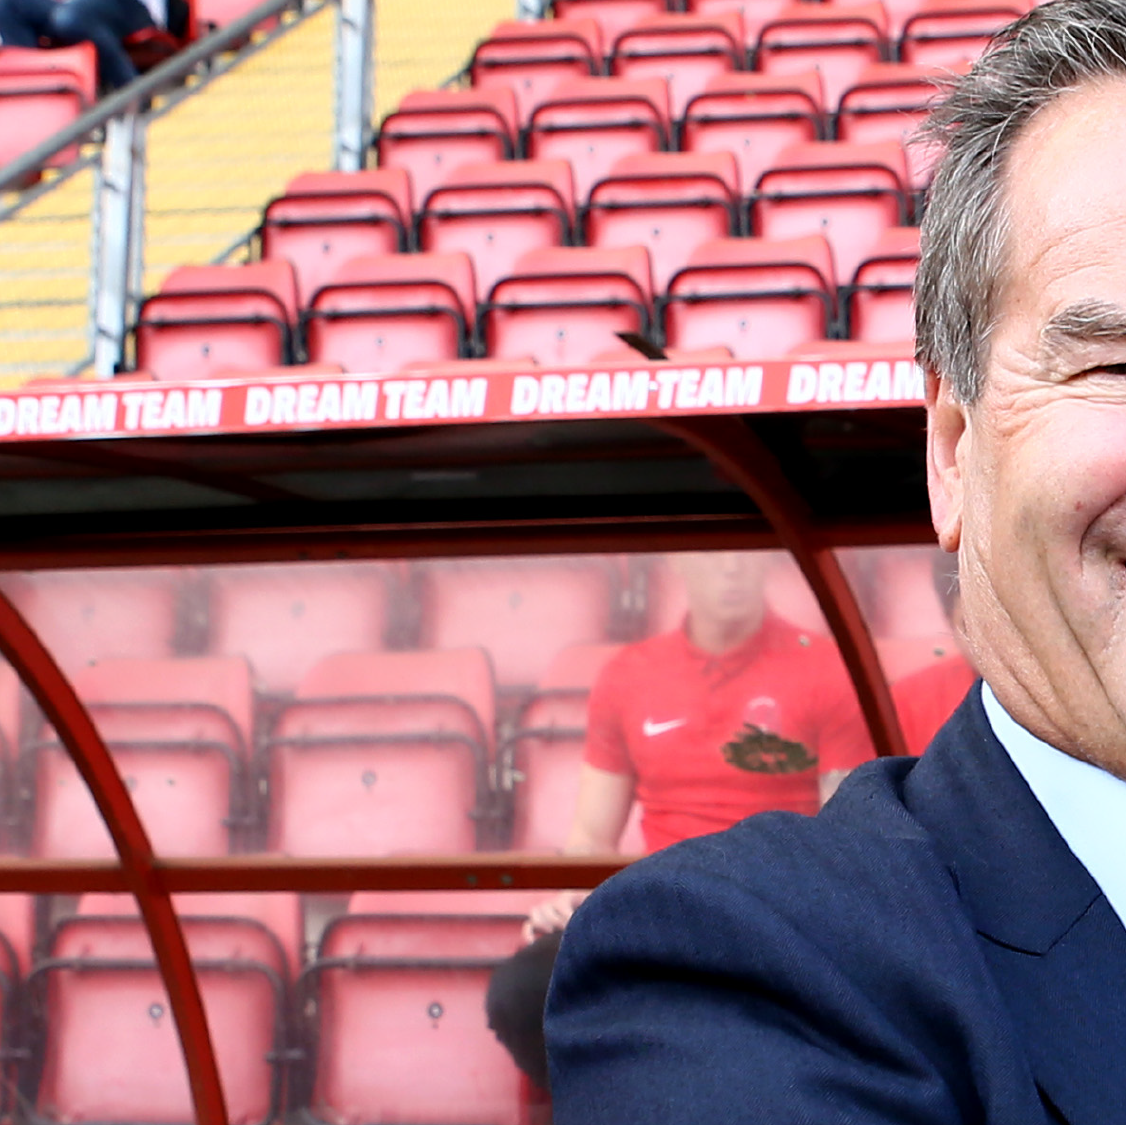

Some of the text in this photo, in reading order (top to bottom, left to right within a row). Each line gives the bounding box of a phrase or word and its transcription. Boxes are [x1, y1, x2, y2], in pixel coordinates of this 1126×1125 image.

[244, 378, 488, 426] DREAM TEAM
[510, 366, 763, 415] DREAM TEAM
[787, 360, 925, 404] DREAM
[122, 389, 222, 429] TEAM
